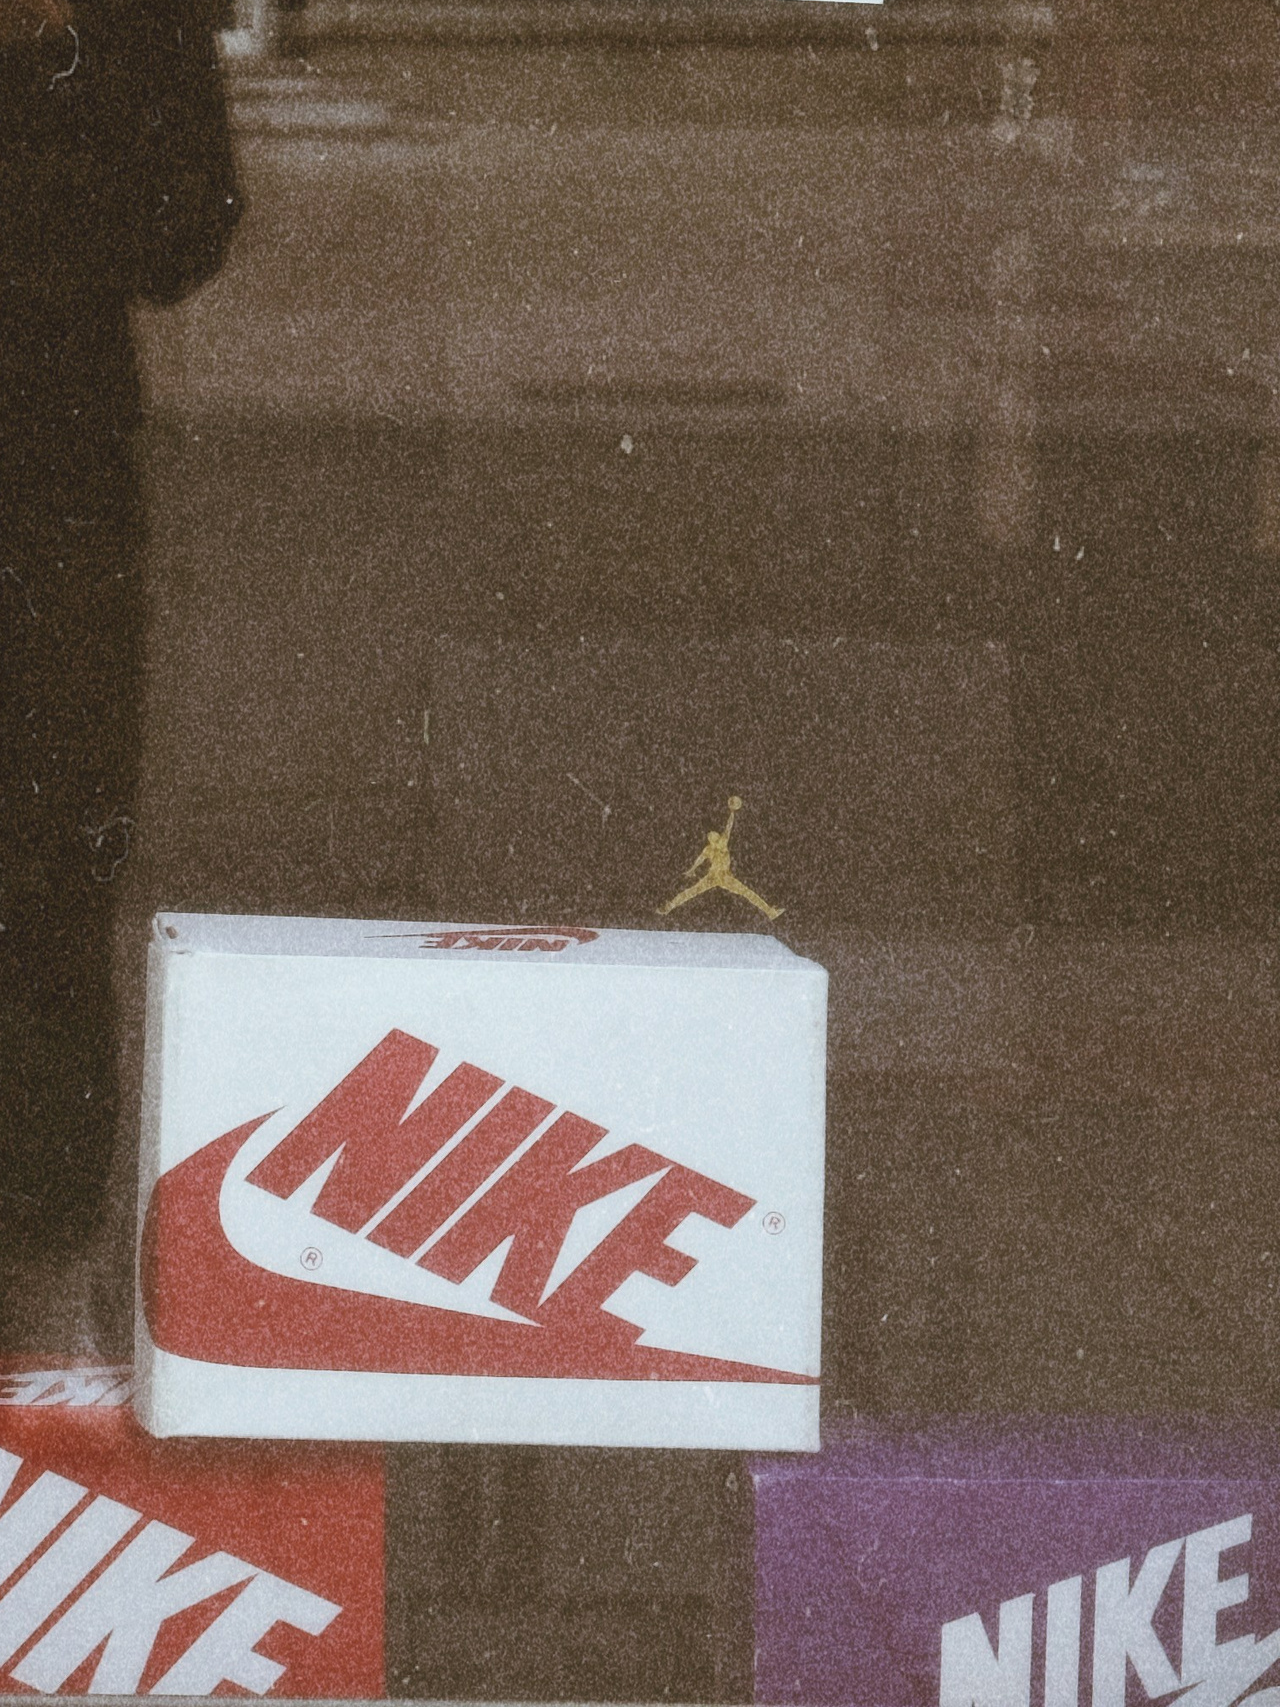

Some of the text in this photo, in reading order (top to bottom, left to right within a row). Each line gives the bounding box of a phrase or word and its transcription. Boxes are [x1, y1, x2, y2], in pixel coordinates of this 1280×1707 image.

[418, 932, 570, 952] NIKE
[244, 1027, 758, 1346] NIKE
[938, 1512, 1254, 1707] NIKE
